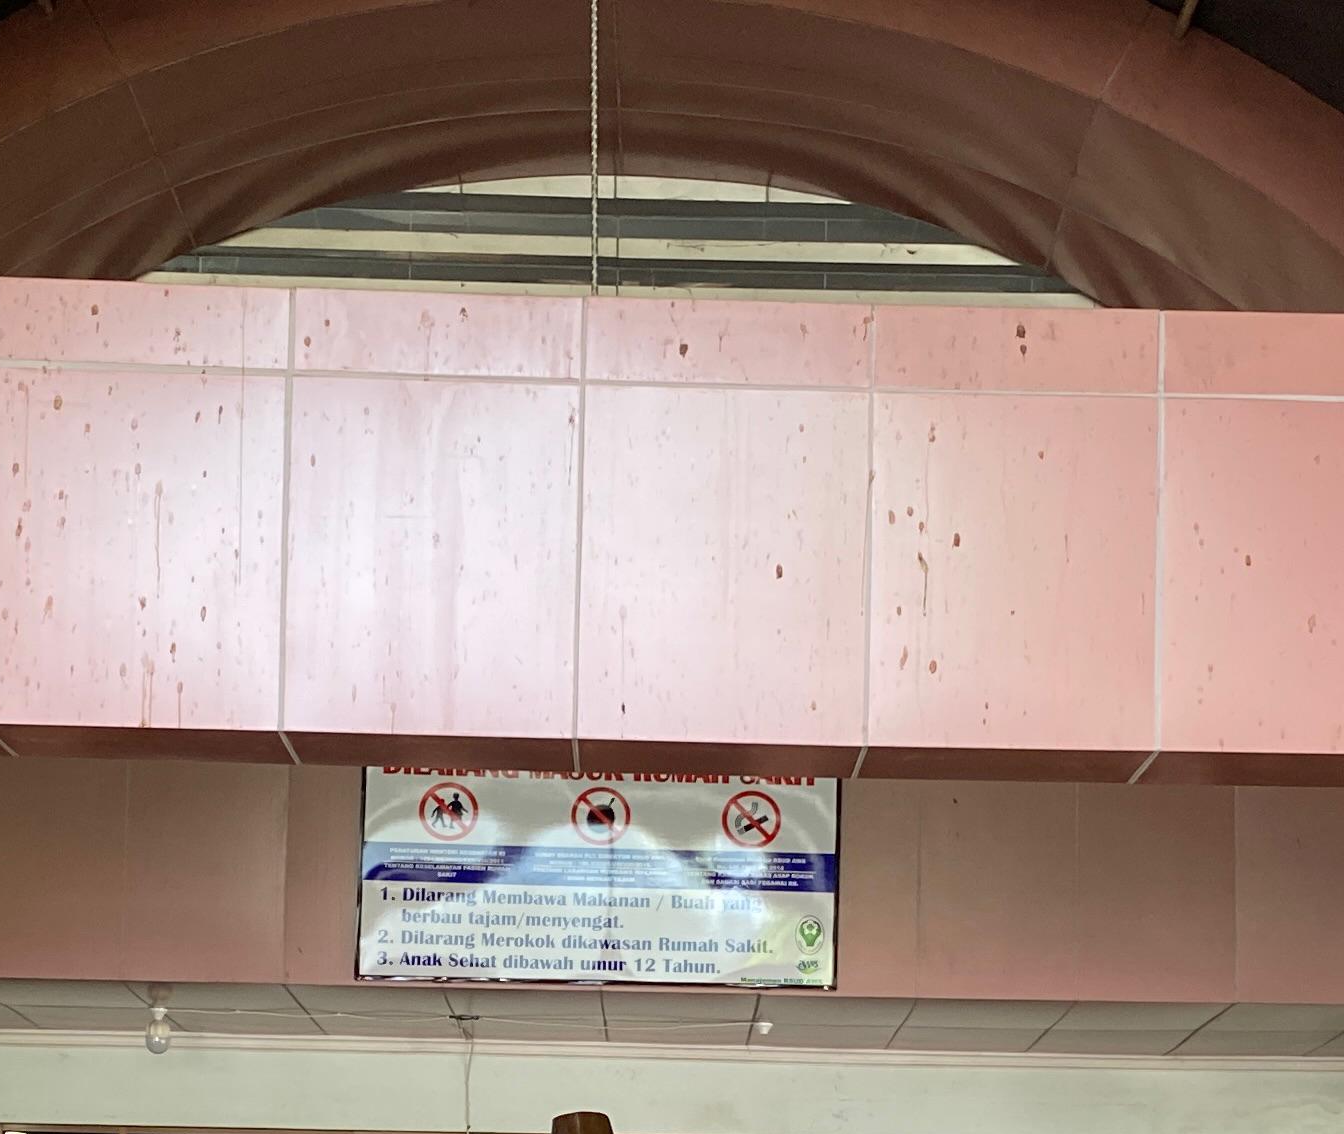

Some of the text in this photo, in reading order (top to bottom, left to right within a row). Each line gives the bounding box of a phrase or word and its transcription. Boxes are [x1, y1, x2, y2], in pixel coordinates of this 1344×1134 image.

[380, 886, 395, 901] 1.
[402, 887, 477, 906] Dilarang
[483, 890, 567, 907] Membawa
[573, 892, 650, 909] Makanan
[671, 895, 714, 910] Buah
[402, 908, 624, 932] berbau tajam/menyengat.
[377, 929, 773, 954] 2. Dilarang Merokok dikawasan Rumah Sakit.
[377, 951, 721, 974] 3. Anak Sehat dibawah umur 12 Tahun.
